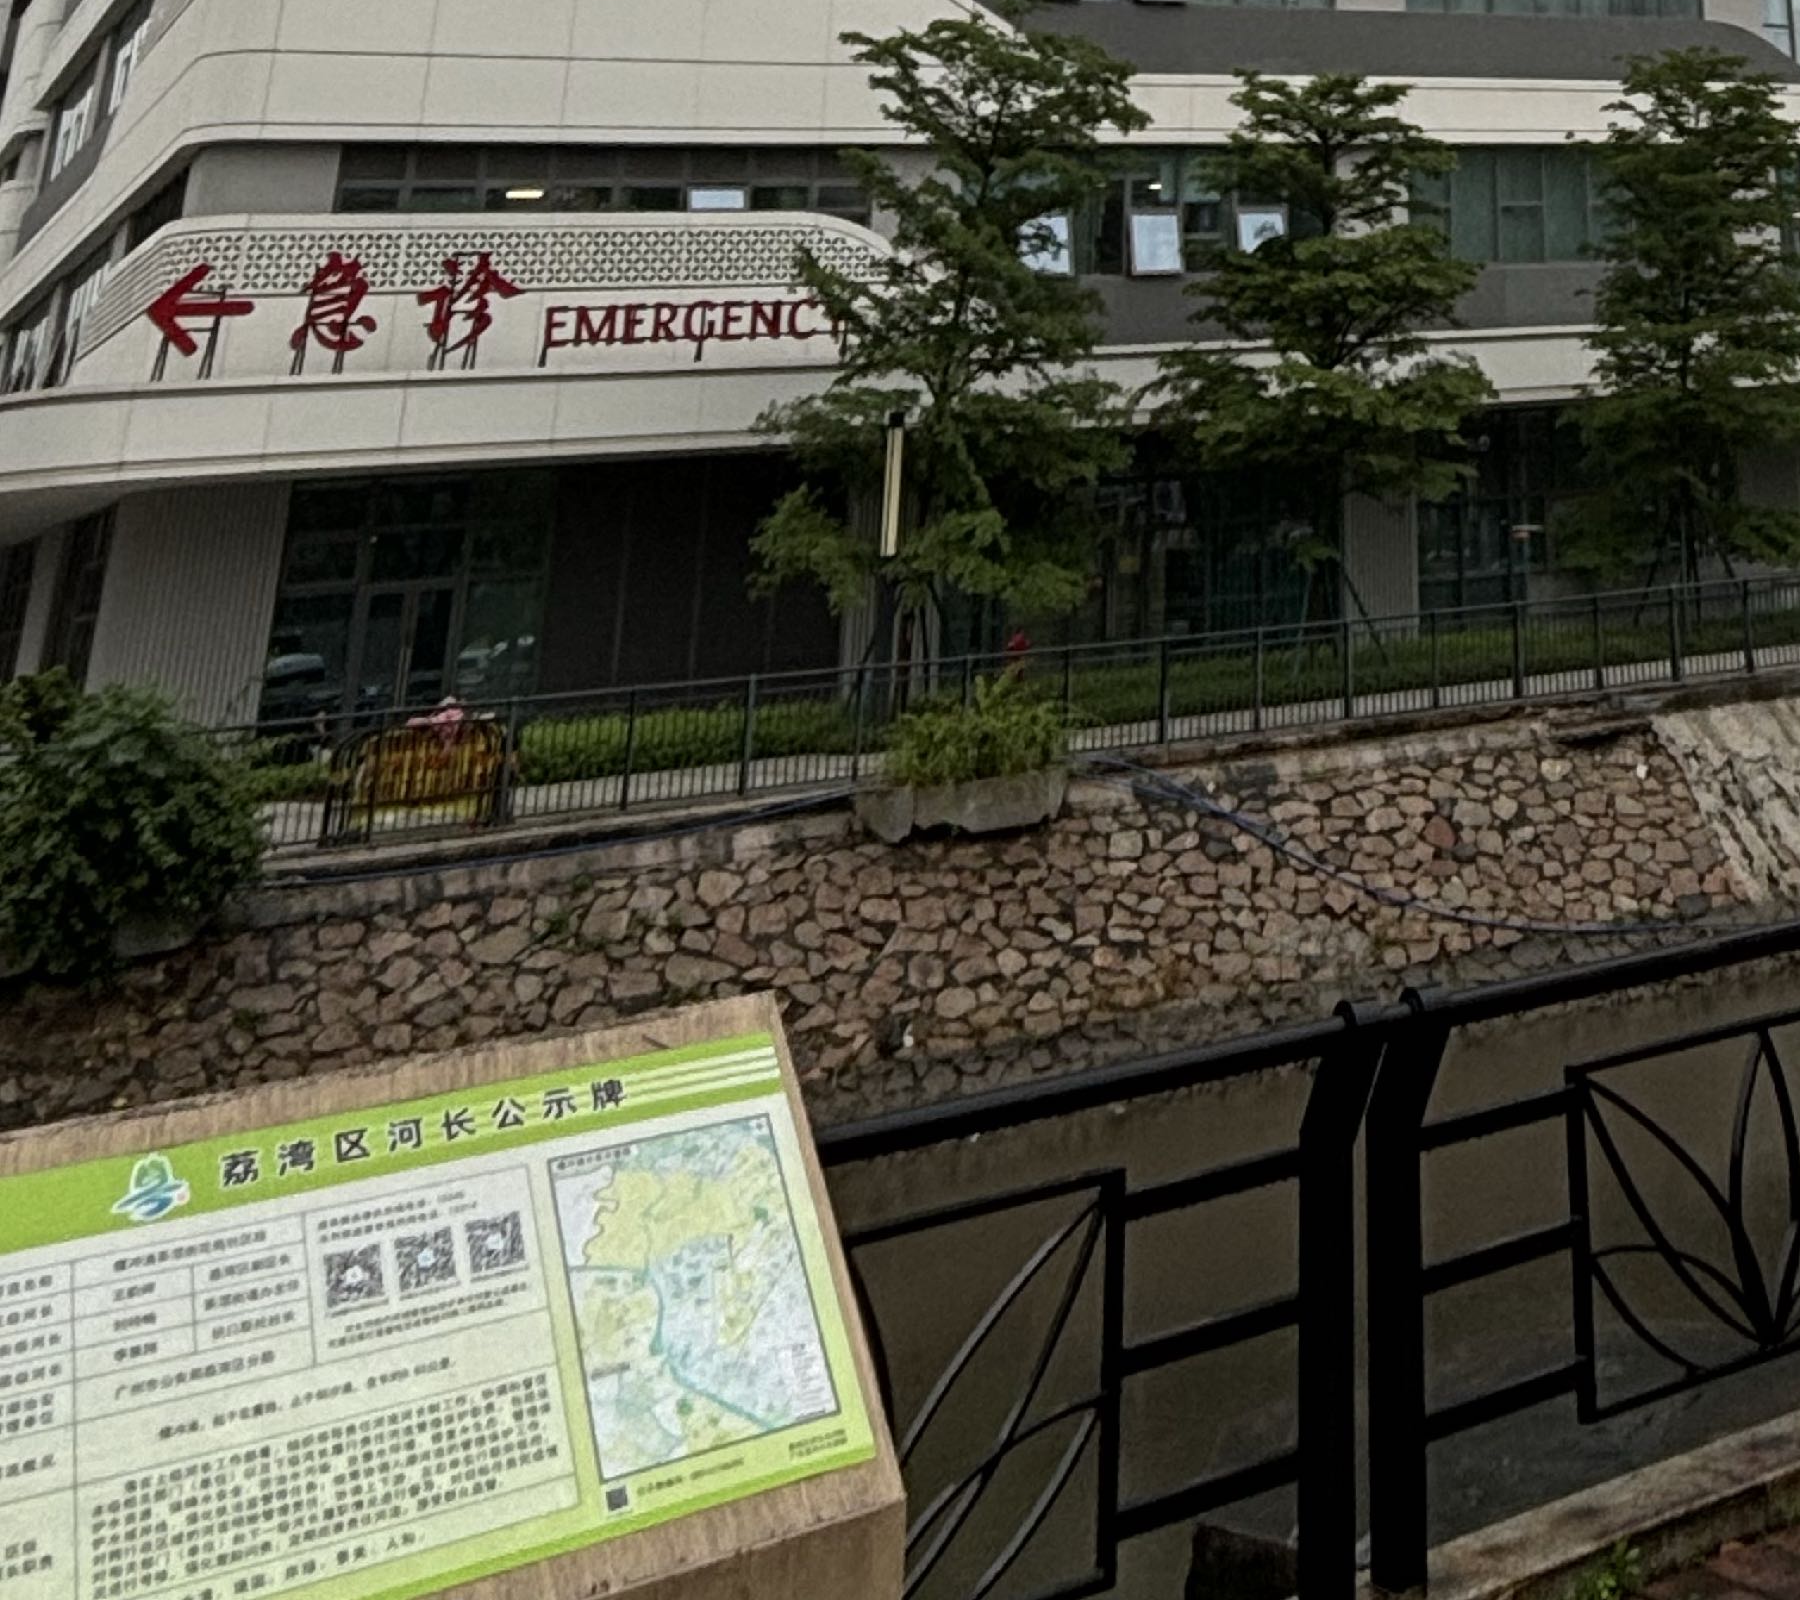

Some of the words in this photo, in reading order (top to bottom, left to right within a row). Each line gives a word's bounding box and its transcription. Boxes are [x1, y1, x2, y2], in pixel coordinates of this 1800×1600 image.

[290, 252, 526, 352] 急诊
[221, 1079, 628, 1187] 荔湾区河长公示牌
